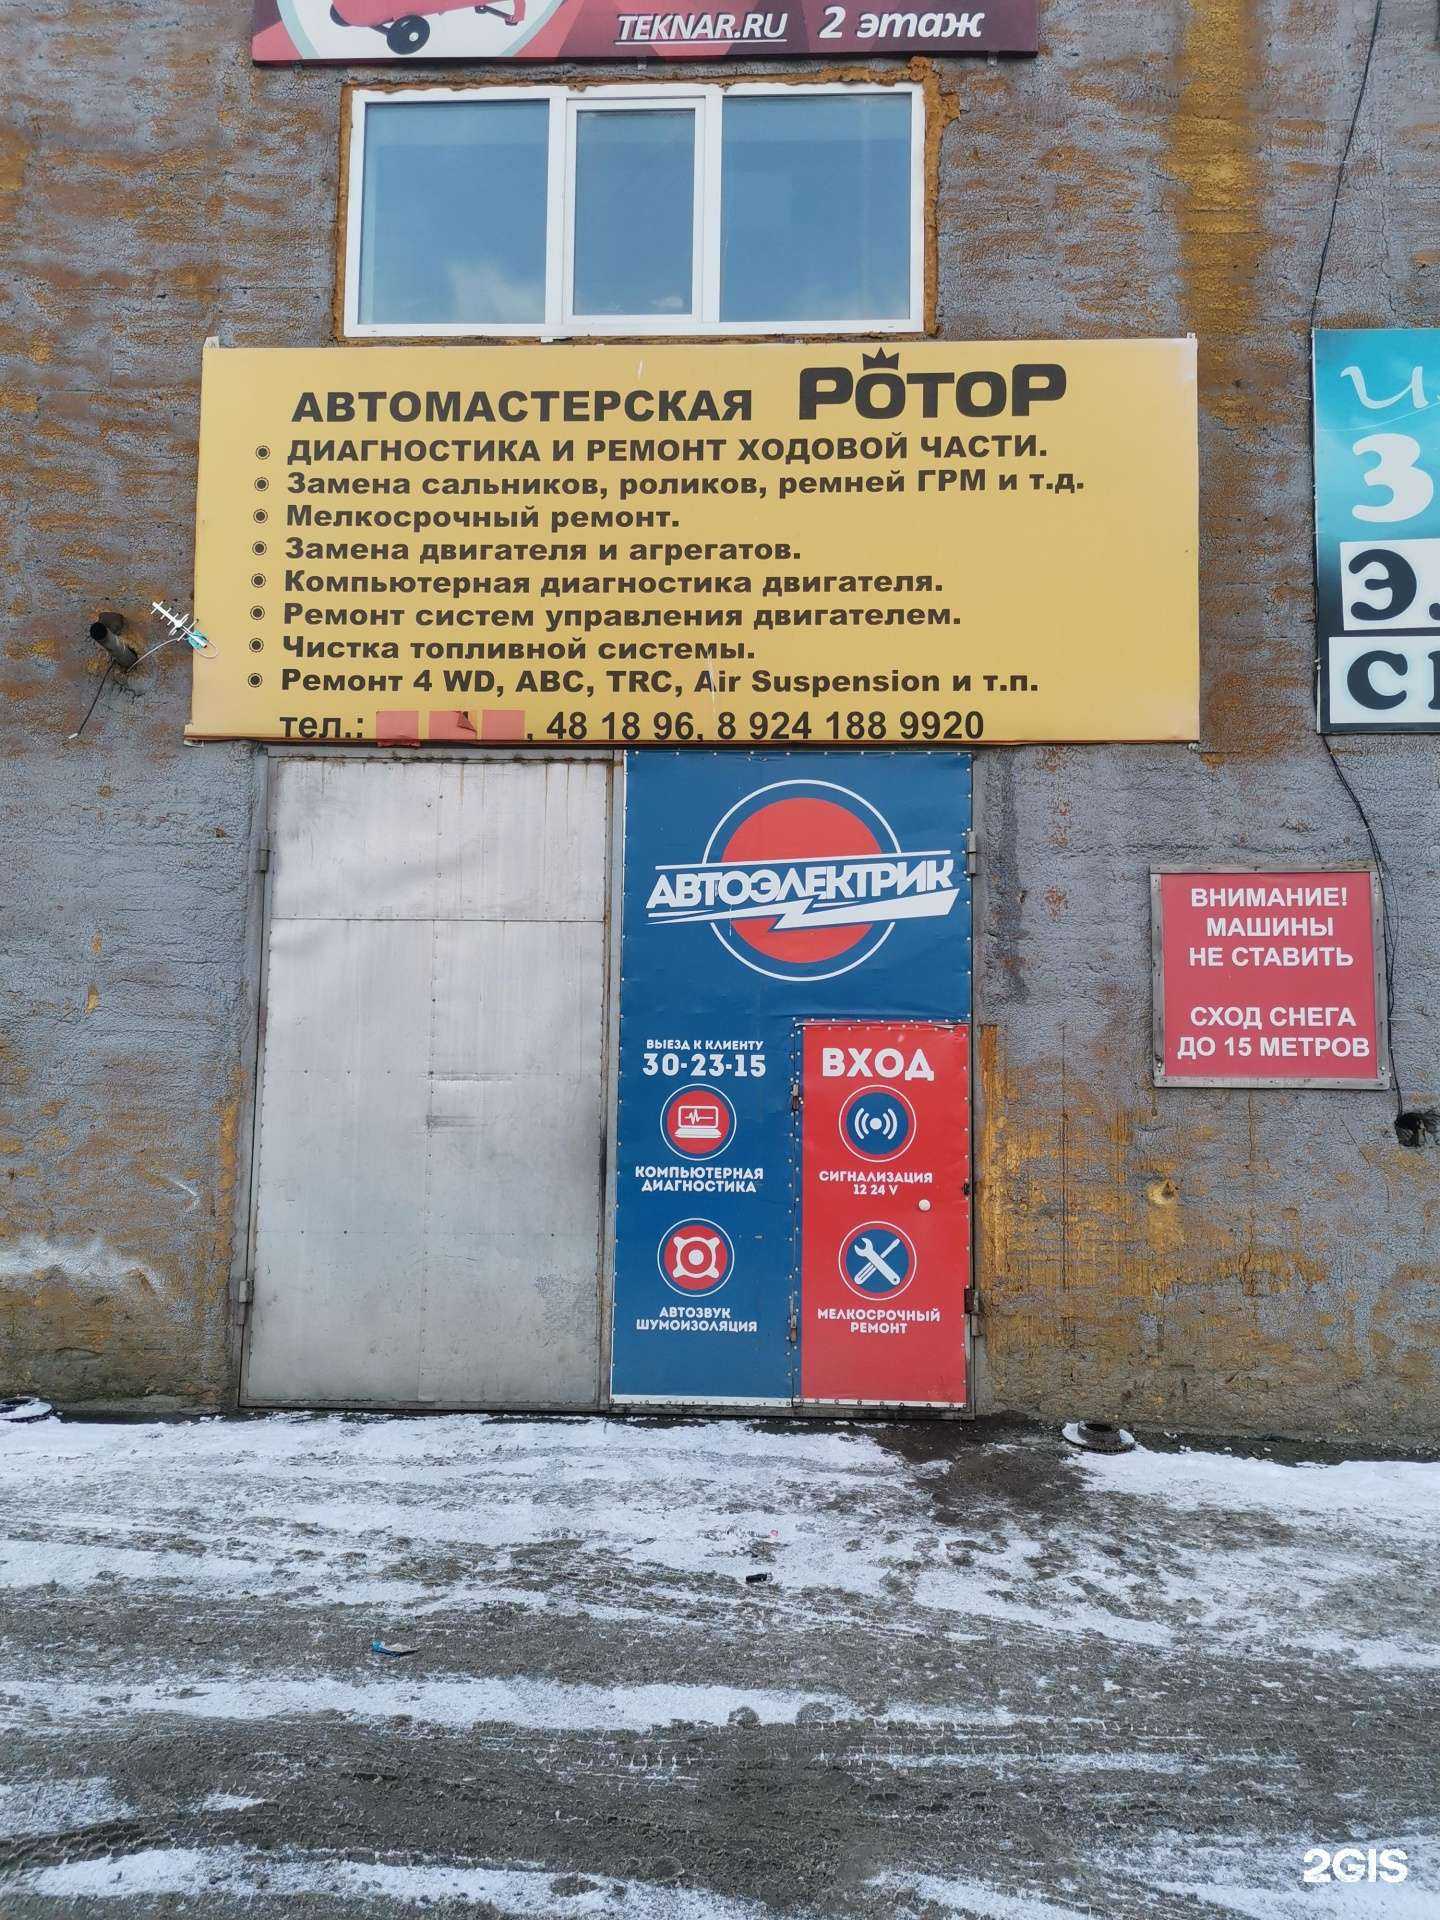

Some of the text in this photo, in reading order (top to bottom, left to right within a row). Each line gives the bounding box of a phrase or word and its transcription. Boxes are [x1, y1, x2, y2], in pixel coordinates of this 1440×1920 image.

[619, 7, 985, 40] TEKNAR.RU 2 этаж
[292, 363, 1066, 422] АВТОМАСТЕРСКАЯ РОТОР
[288, 432, 1046, 465] ДИАГНОСТИКА И РЕМОНТ ХОДОВОЙ ЧАСТИ.
[288, 469, 1083, 500] Замена сальников, роликов, ремней ГРМ и т.д.
[287, 505, 679, 533] Мелкосрочный ремонт.
[286, 537, 800, 565] Замена двигателя и агрегатов.
[286, 570, 942, 598] Компьютерная диагностика двигателя.
[285, 603, 960, 632] Ремонт систем управления двигателем.
[284, 636, 754, 659] Чистка топливной системы.
[282, 669, 403, 691] Ремонт
[413, 670, 432, 691] 4
[443, 670, 503, 697] WD,
[606, 671, 682, 697] TRC,
[694, 671, 741, 692] Air
[752, 670, 939, 697] Suspension
[953, 676, 971, 691] и
[983, 675, 1037, 691] т.п.
[1347, 650, 1440, 710] С
[279, 717, 363, 738] тел.:
[546, 711, 588, 739] 48
[602, 711, 641, 739] 18
[717, 711, 737, 739] 8
[749, 711, 812, 739] 924
[826, 711, 887, 739] 188
[900, 711, 985, 739] 9920
[646, 859, 954, 908] АВТОЭЛЕКТРИК
[1192, 888, 1346, 906] ВНИМАНИЕ!
[1207, 917, 1333, 936] МАШИНЫ
[1190, 947, 1353, 966] НЕ СТАВИТЬ
[1191, 1007, 1356, 1029] СХОД СНЕГА
[647, 1040, 763, 1050] ВЫЕЗД К КЛИЕНТУ
[1177, 1037, 1369, 1059] ДО 15 МЕТРОВ
[643, 1053, 766, 1077] 30-23-15
[823, 1048, 934, 1081] ВХОД
[636, 1166, 763, 1181] КОМПЬЮТЕРНАЯ
[819, 1171, 932, 1183] СИГНАЛИЗАЦИЯ
[642, 1180, 756, 1192] ДИАГНОСТИКА
[854, 1184, 898, 1195] 12 24 V
[659, 1307, 730, 1318] АВТОЗВУК
[818, 1308, 940, 1321] МЕЛКОСРОЧНЫЙ
[637, 1319, 757, 1332] ШУМОИЗОЛЯЦИЯ
[851, 1322, 907, 1333] РЕМОНТ
